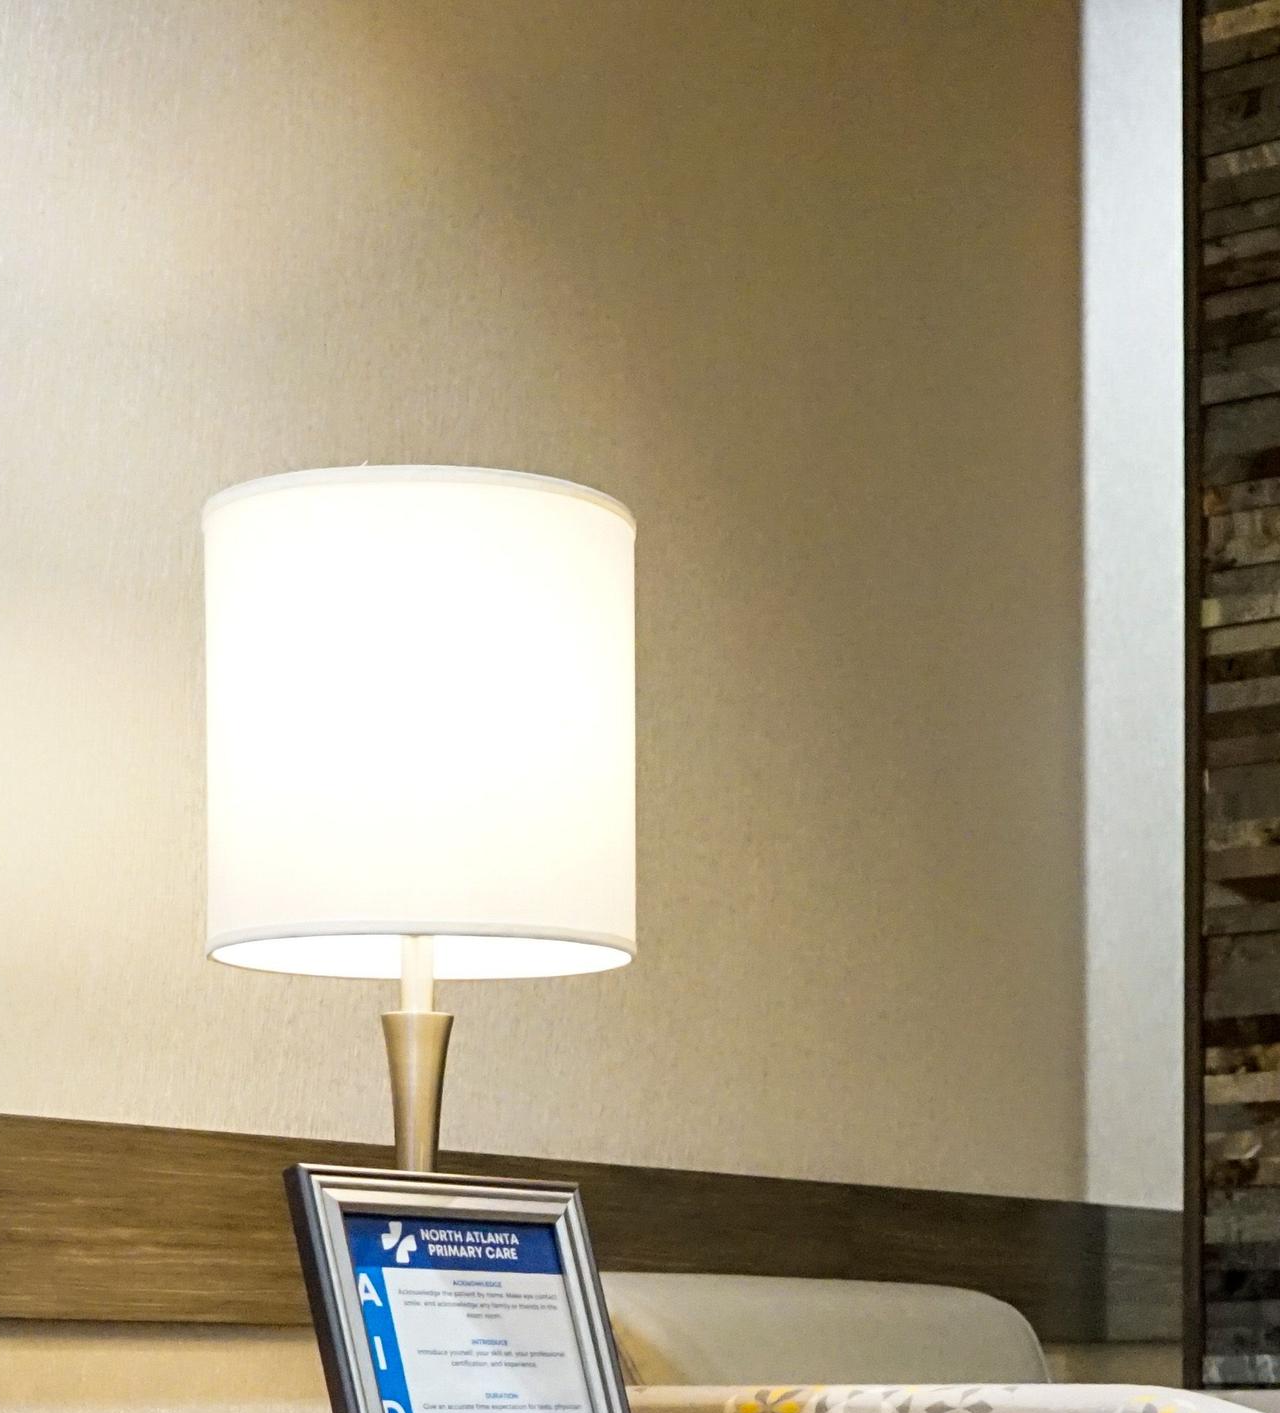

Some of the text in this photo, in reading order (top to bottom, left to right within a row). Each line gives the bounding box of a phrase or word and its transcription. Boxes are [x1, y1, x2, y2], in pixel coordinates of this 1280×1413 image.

[420, 1228, 520, 1245] NORTH ATLANTA
[428, 1244, 519, 1260] PRIMARY CARE
